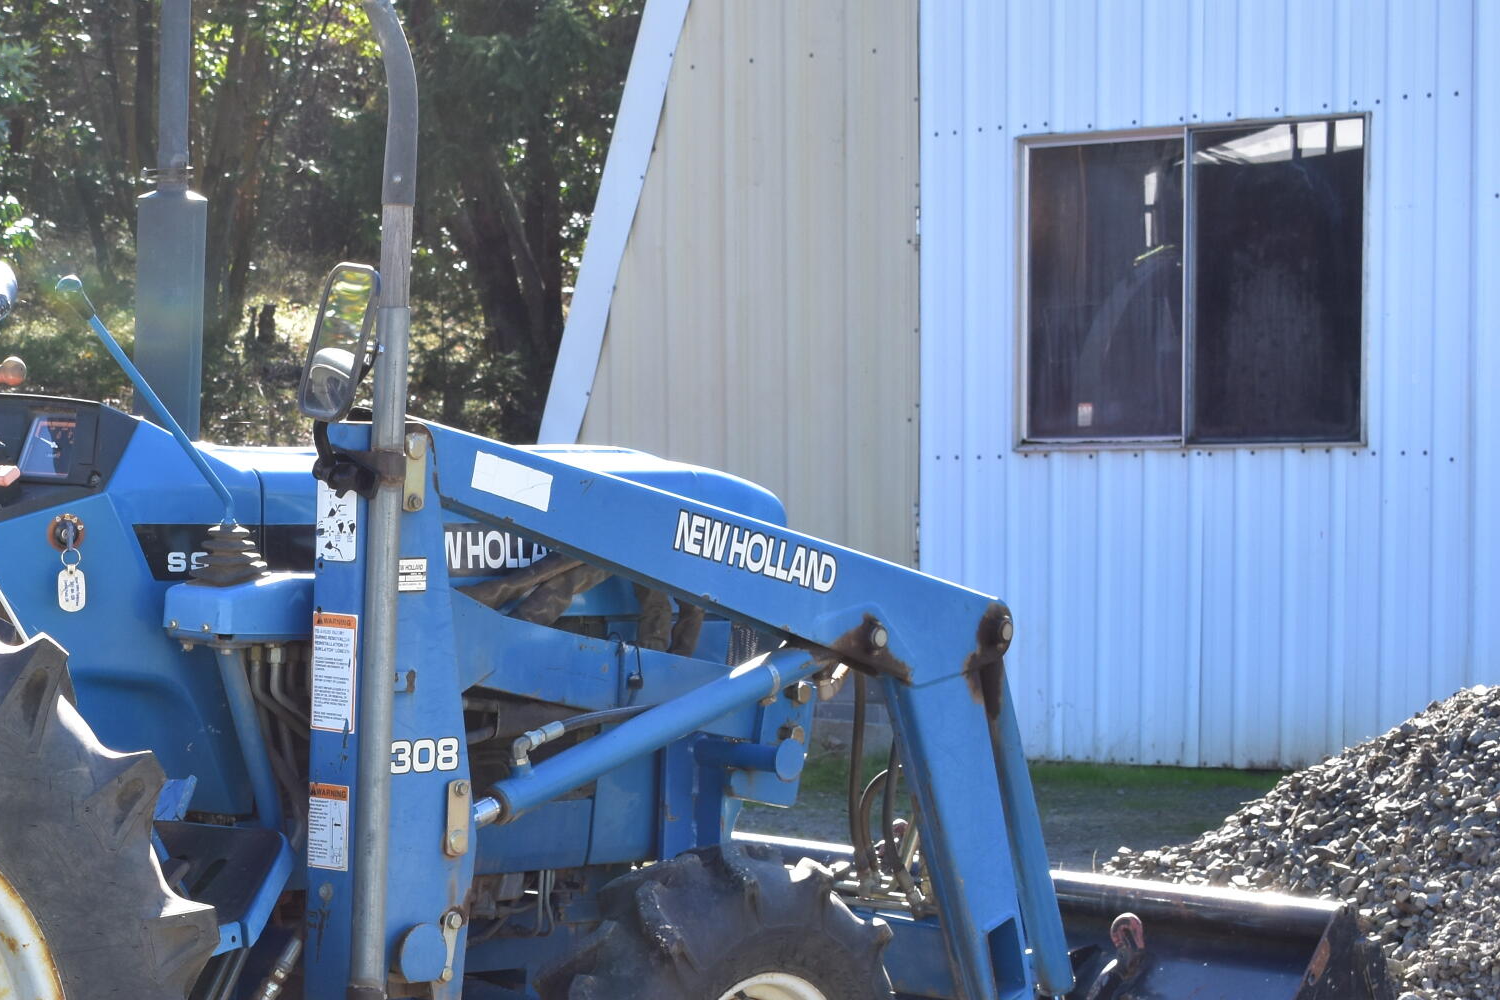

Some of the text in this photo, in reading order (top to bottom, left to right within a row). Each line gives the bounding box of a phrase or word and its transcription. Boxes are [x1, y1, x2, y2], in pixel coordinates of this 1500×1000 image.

[674, 509, 838, 594] NEW HOLLAND
[323, 617, 352, 626] WARNING
[390, 736, 460, 774] 308
[316, 788, 347, 799] WARNING
